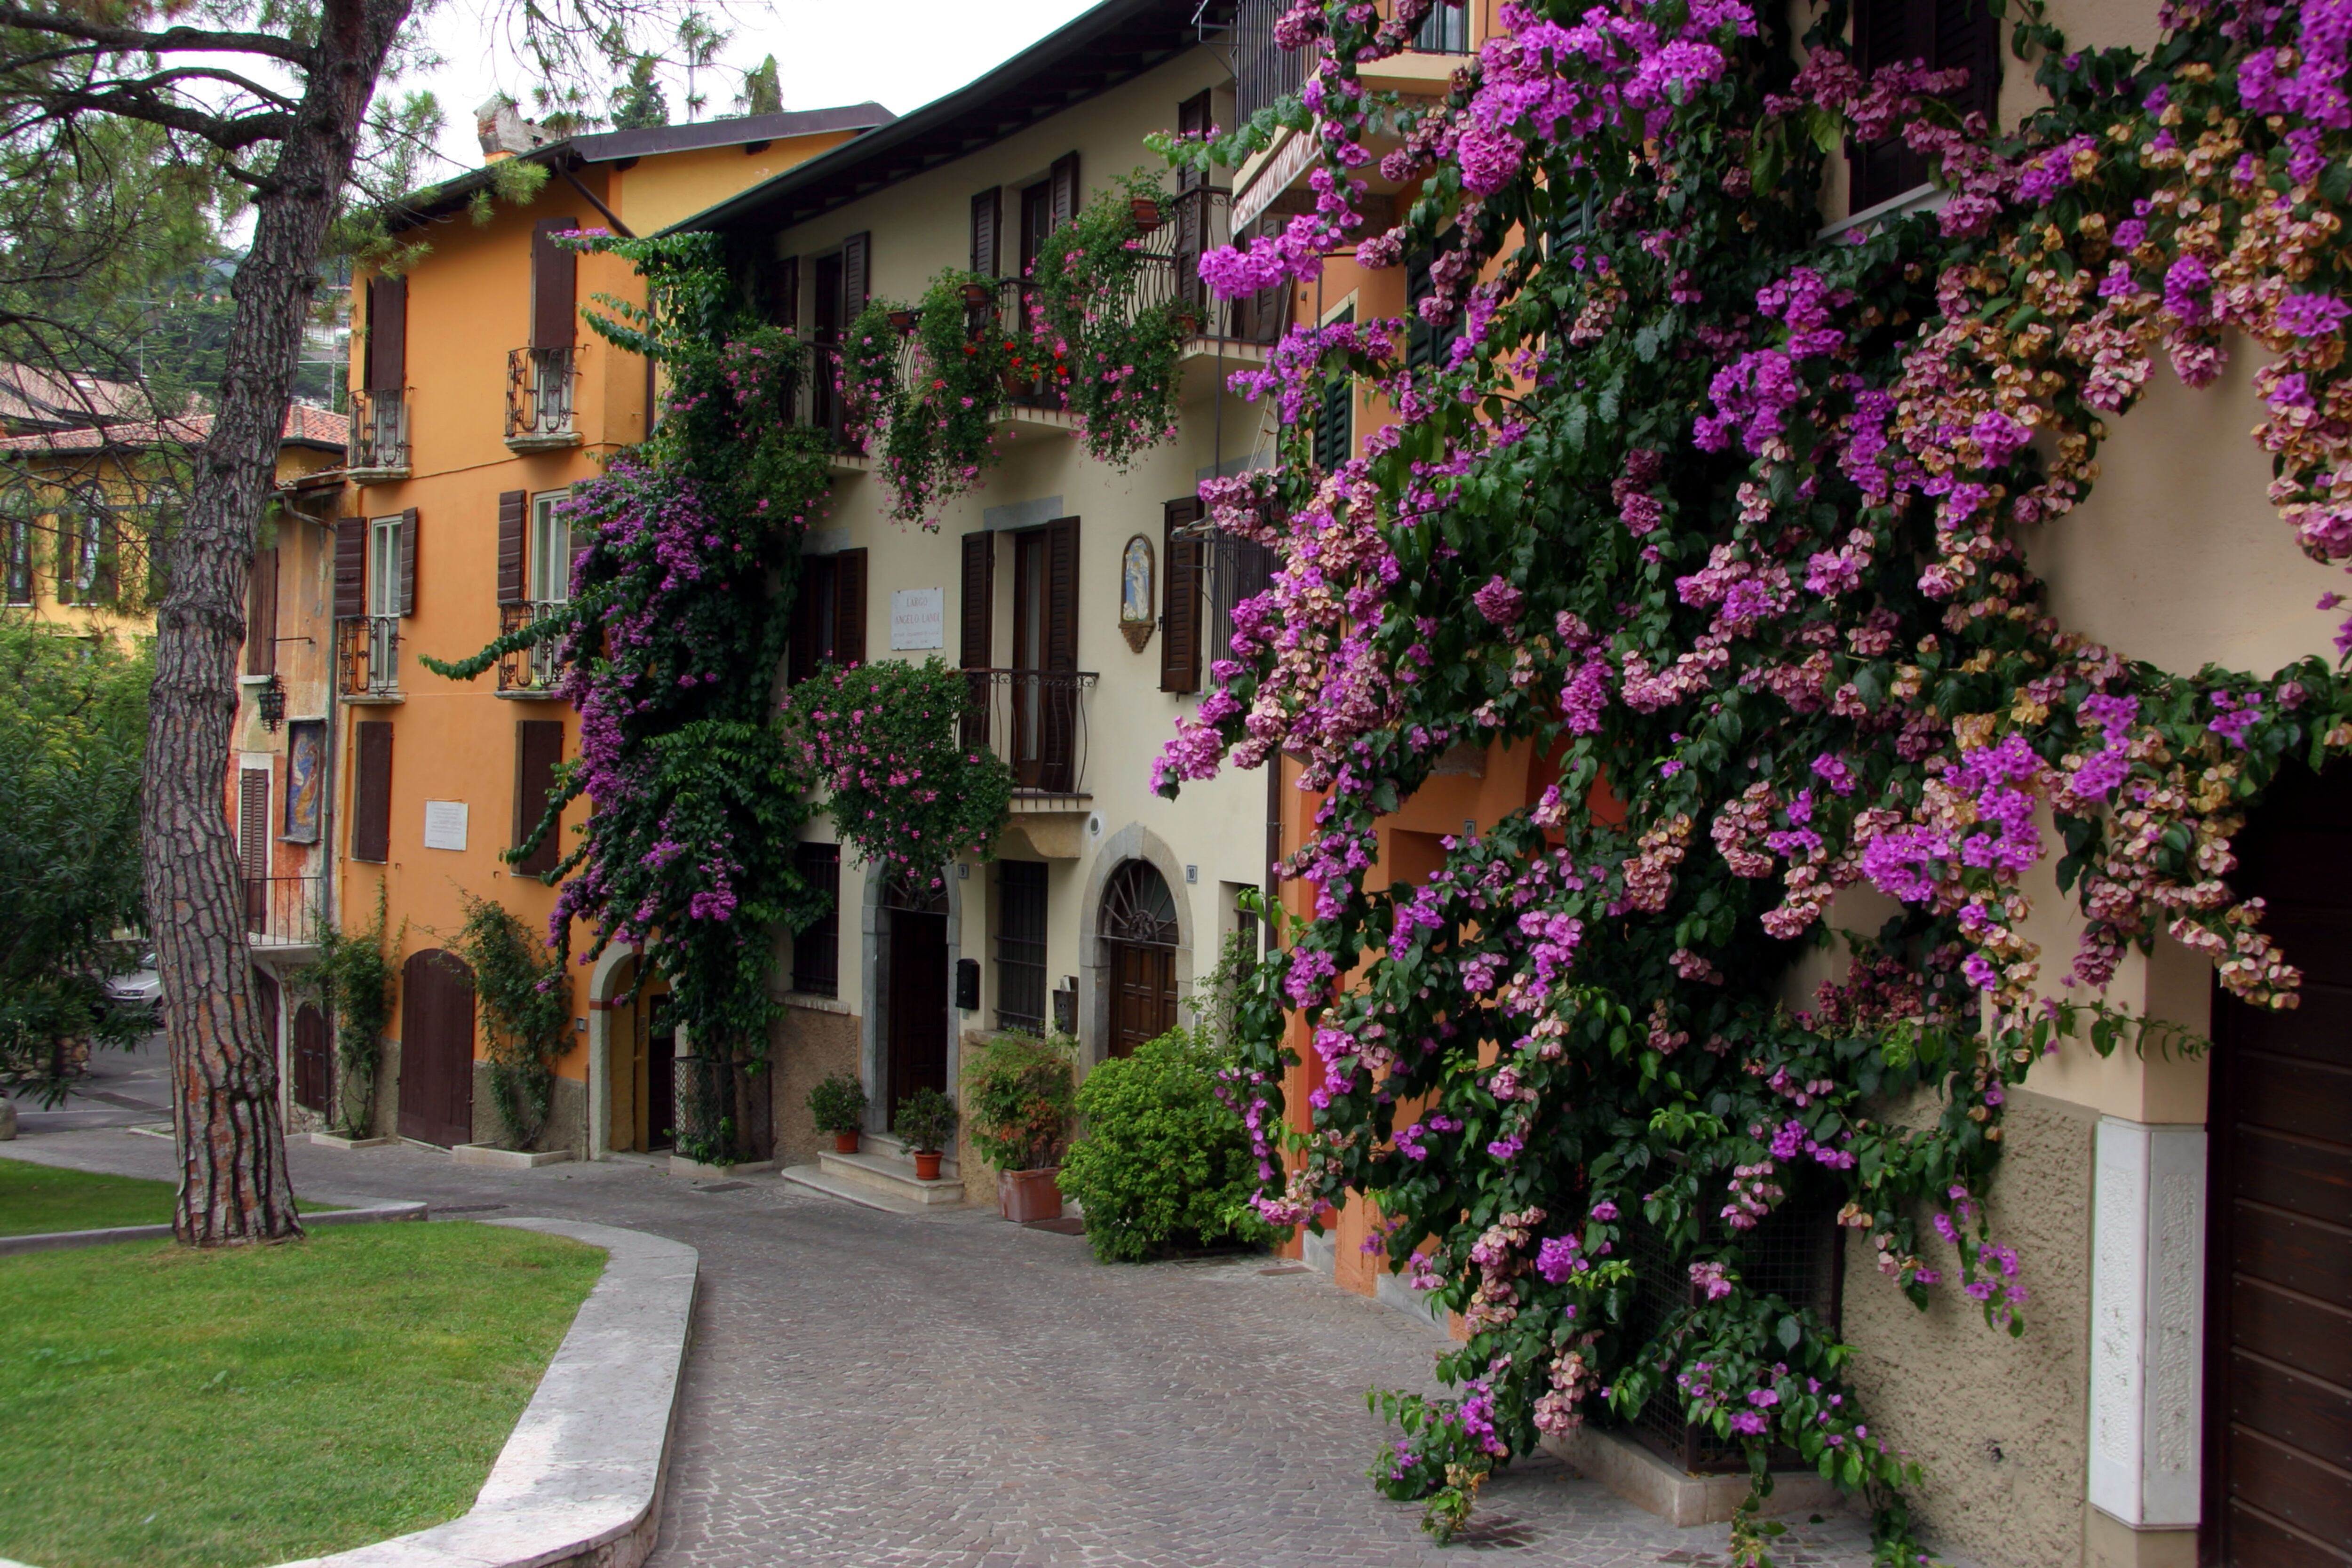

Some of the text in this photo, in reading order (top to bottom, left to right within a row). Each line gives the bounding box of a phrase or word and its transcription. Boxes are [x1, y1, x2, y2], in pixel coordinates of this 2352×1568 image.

[907, 597, 928, 607] LARGO
[896, 613, 919, 624] ANGELO
[1189, 868, 1195, 879] 10
